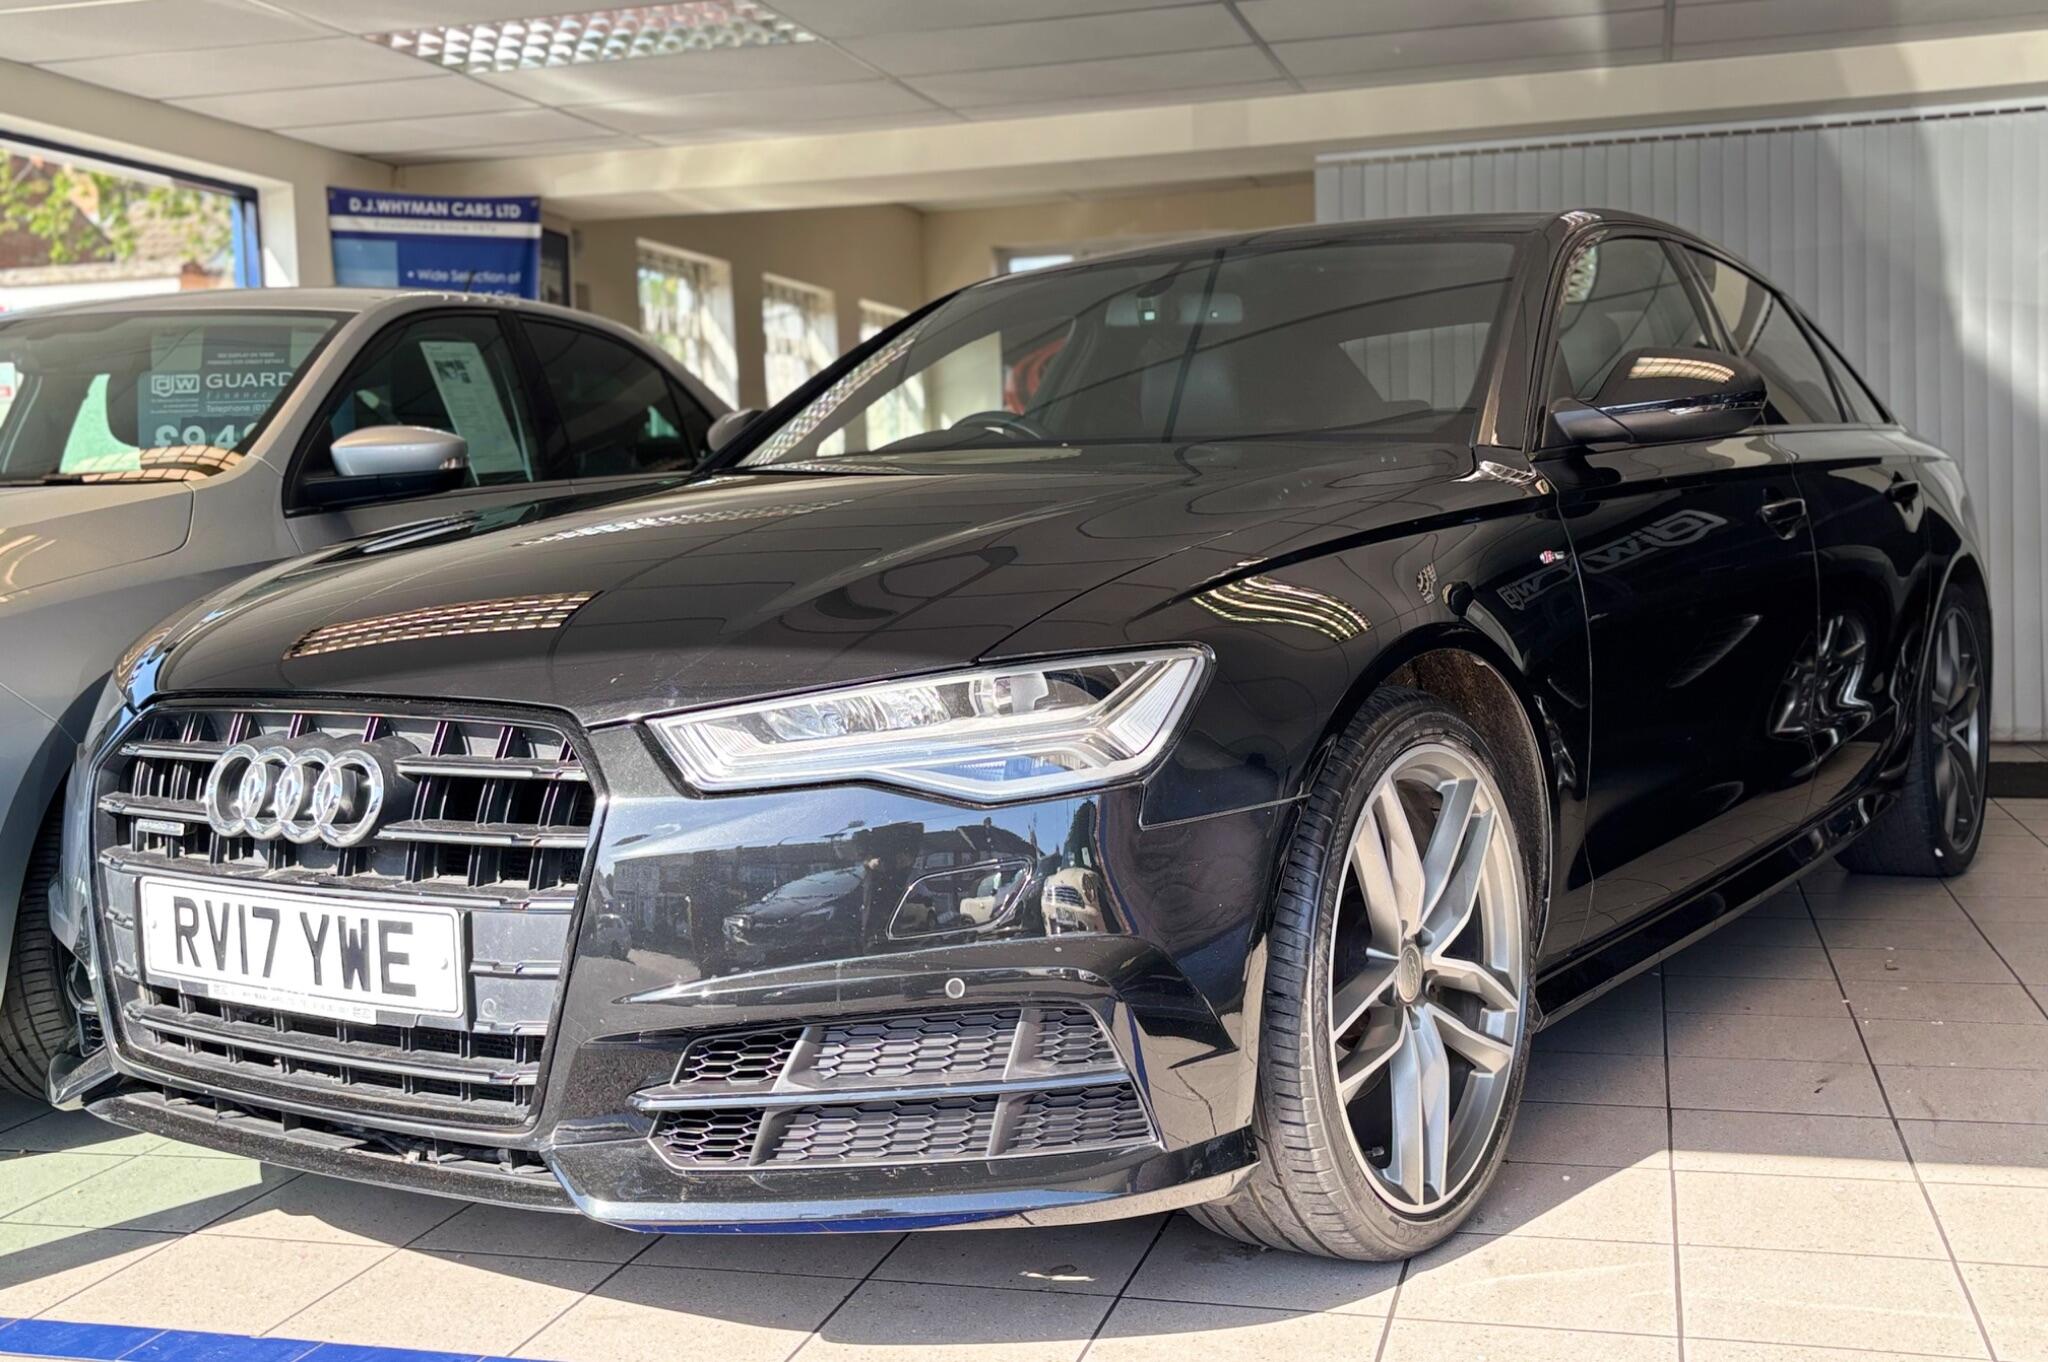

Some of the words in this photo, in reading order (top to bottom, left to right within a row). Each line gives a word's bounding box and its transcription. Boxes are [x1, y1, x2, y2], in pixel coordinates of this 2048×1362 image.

[452, 203, 494, 218] CARS
[496, 205, 521, 219] LTD
[417, 268, 448, 281] Wide
[508, 270, 521, 283] of
[206, 404, 250, 414] Telephone
[173, 895, 281, 978] RV17
[299, 911, 417, 998] YWE
